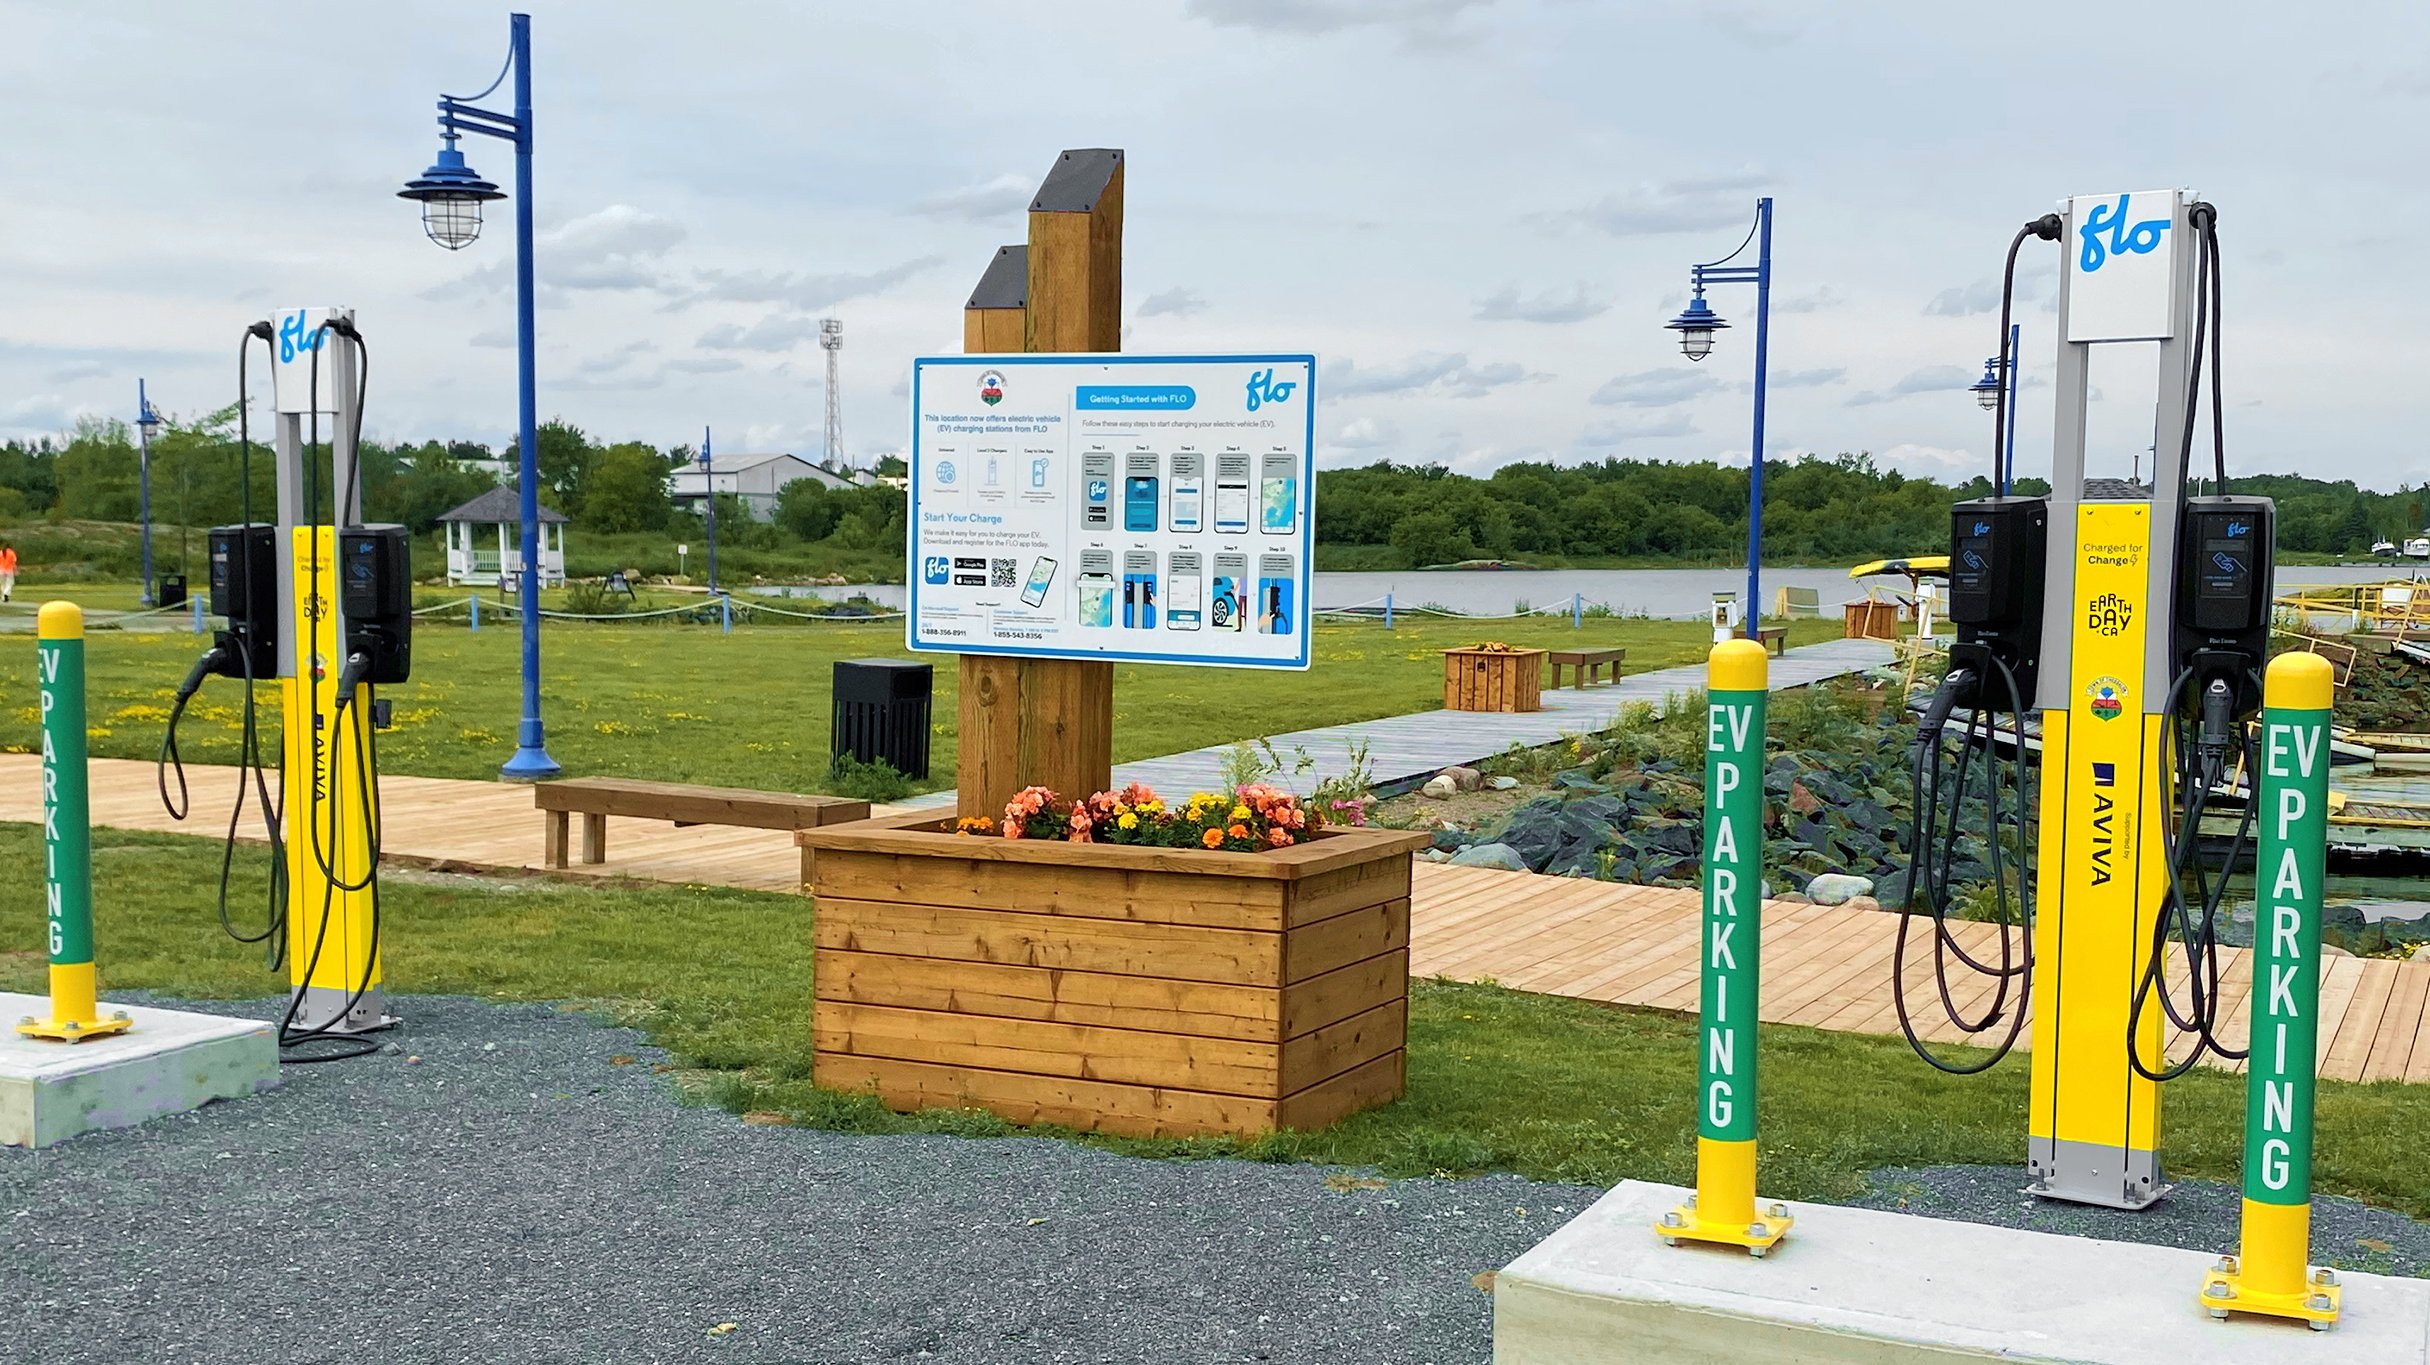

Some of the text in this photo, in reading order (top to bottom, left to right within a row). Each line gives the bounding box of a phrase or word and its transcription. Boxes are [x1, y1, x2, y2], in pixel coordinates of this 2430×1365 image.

[2079, 193, 2171, 273] flo
[279, 309, 331, 363] flo
[1089, 394, 1187, 405] Getting Started with FLO
[1246, 368, 1297, 412] flo
[924, 414, 940, 422] This
[940, 414, 969, 422] location
[986, 414, 1006, 423] offers
[1007, 414, 1035, 423] electric
[1035, 415, 1062, 423] vehicle
[937, 424, 1048, 434] (EV) charging stations from FLO
[1081, 419, 1101, 427] Follow
[1101, 419, 1118, 427] these
[1119, 421, 1133, 429] easy
[1133, 420, 1149, 429] steps
[1171, 420, 1198, 429] charging
[1198, 421, 1212, 429] your
[1236, 420, 1259, 428] vehicle
[923, 512, 1003, 526] Start Your Charge
[2227, 521, 2251, 537] flo
[923, 537, 952, 545] Download
[952, 538, 963, 546] and
[963, 538, 985, 547] register
[986, 538, 994, 546] for
[994, 539, 1005, 547] the
[1005, 539, 1019, 547] FLO
[1019, 541, 1031, 549] app
[955, 530, 968, 538] easy
[996, 531, 1016, 539] charge
[2083, 543, 2143, 554] Charged for
[927, 557, 949, 578] flo
[2088, 555, 2129, 567] Change
[2090, 593, 2132, 613] EARTH
[2089, 609, 2132, 631] DAY
[1708, 704, 1753, 753] EV
[2267, 724, 2321, 778] EV
[41, 690, 63, 956] PARKING
[2091, 792, 2114, 887] AVIVA
[2122, 812, 2132, 860] Supported by
[1709, 762, 1740, 1128] PARKING
[2261, 788, 2307, 1191] PARKING
